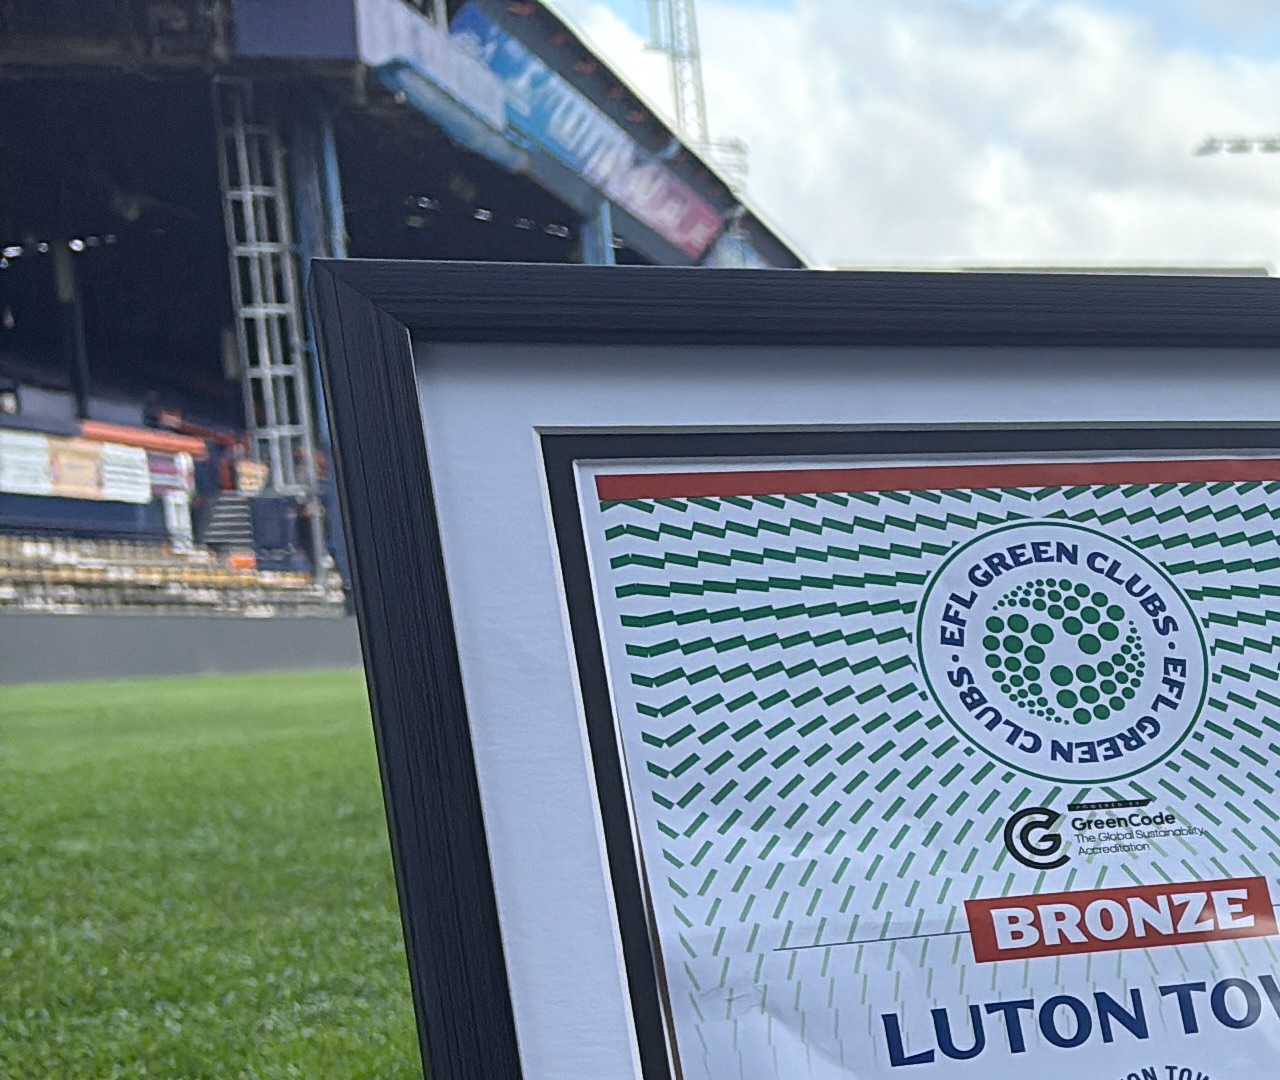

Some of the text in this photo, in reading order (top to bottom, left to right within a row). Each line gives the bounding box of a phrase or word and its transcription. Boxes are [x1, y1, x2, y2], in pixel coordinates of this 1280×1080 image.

[940, 541, 1179, 647] EFL GREEN CLUBS
[946, 656, 1187, 764] EFL GREEN CLUBS
[1071, 812, 1176, 831] GreenCode
[1074, 825, 1204, 844] The Global Sustainability
[1078, 842, 1150, 856] Accreditation
[989, 889, 1255, 950] BRONZE
[881, 988, 1150, 1067] LUTON
